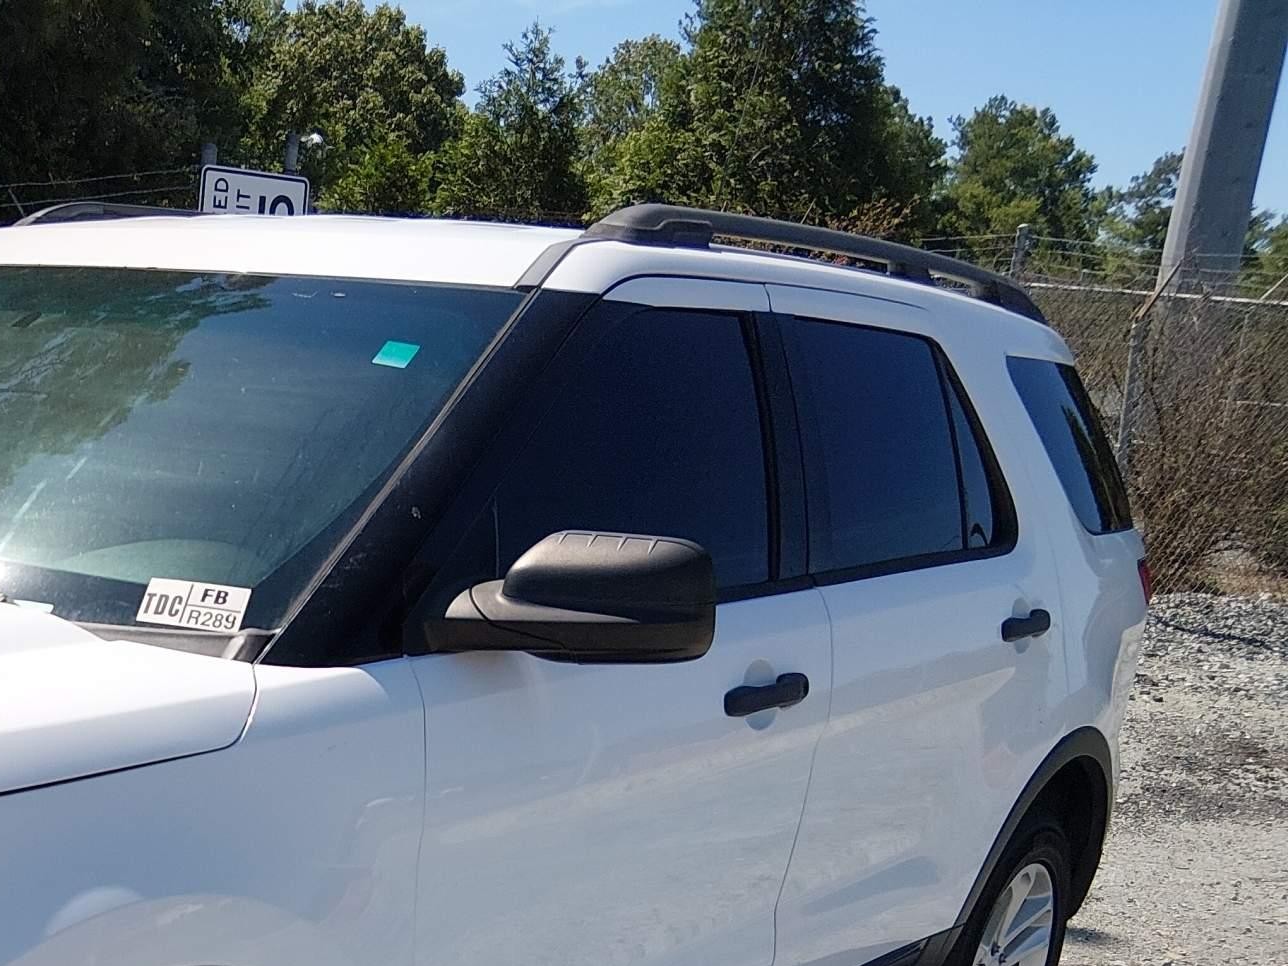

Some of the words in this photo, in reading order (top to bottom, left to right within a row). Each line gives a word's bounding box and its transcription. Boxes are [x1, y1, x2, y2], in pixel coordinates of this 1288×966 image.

[143, 592, 184, 618] TDC
[200, 588, 229, 605] FB
[186, 609, 237, 630] R289
